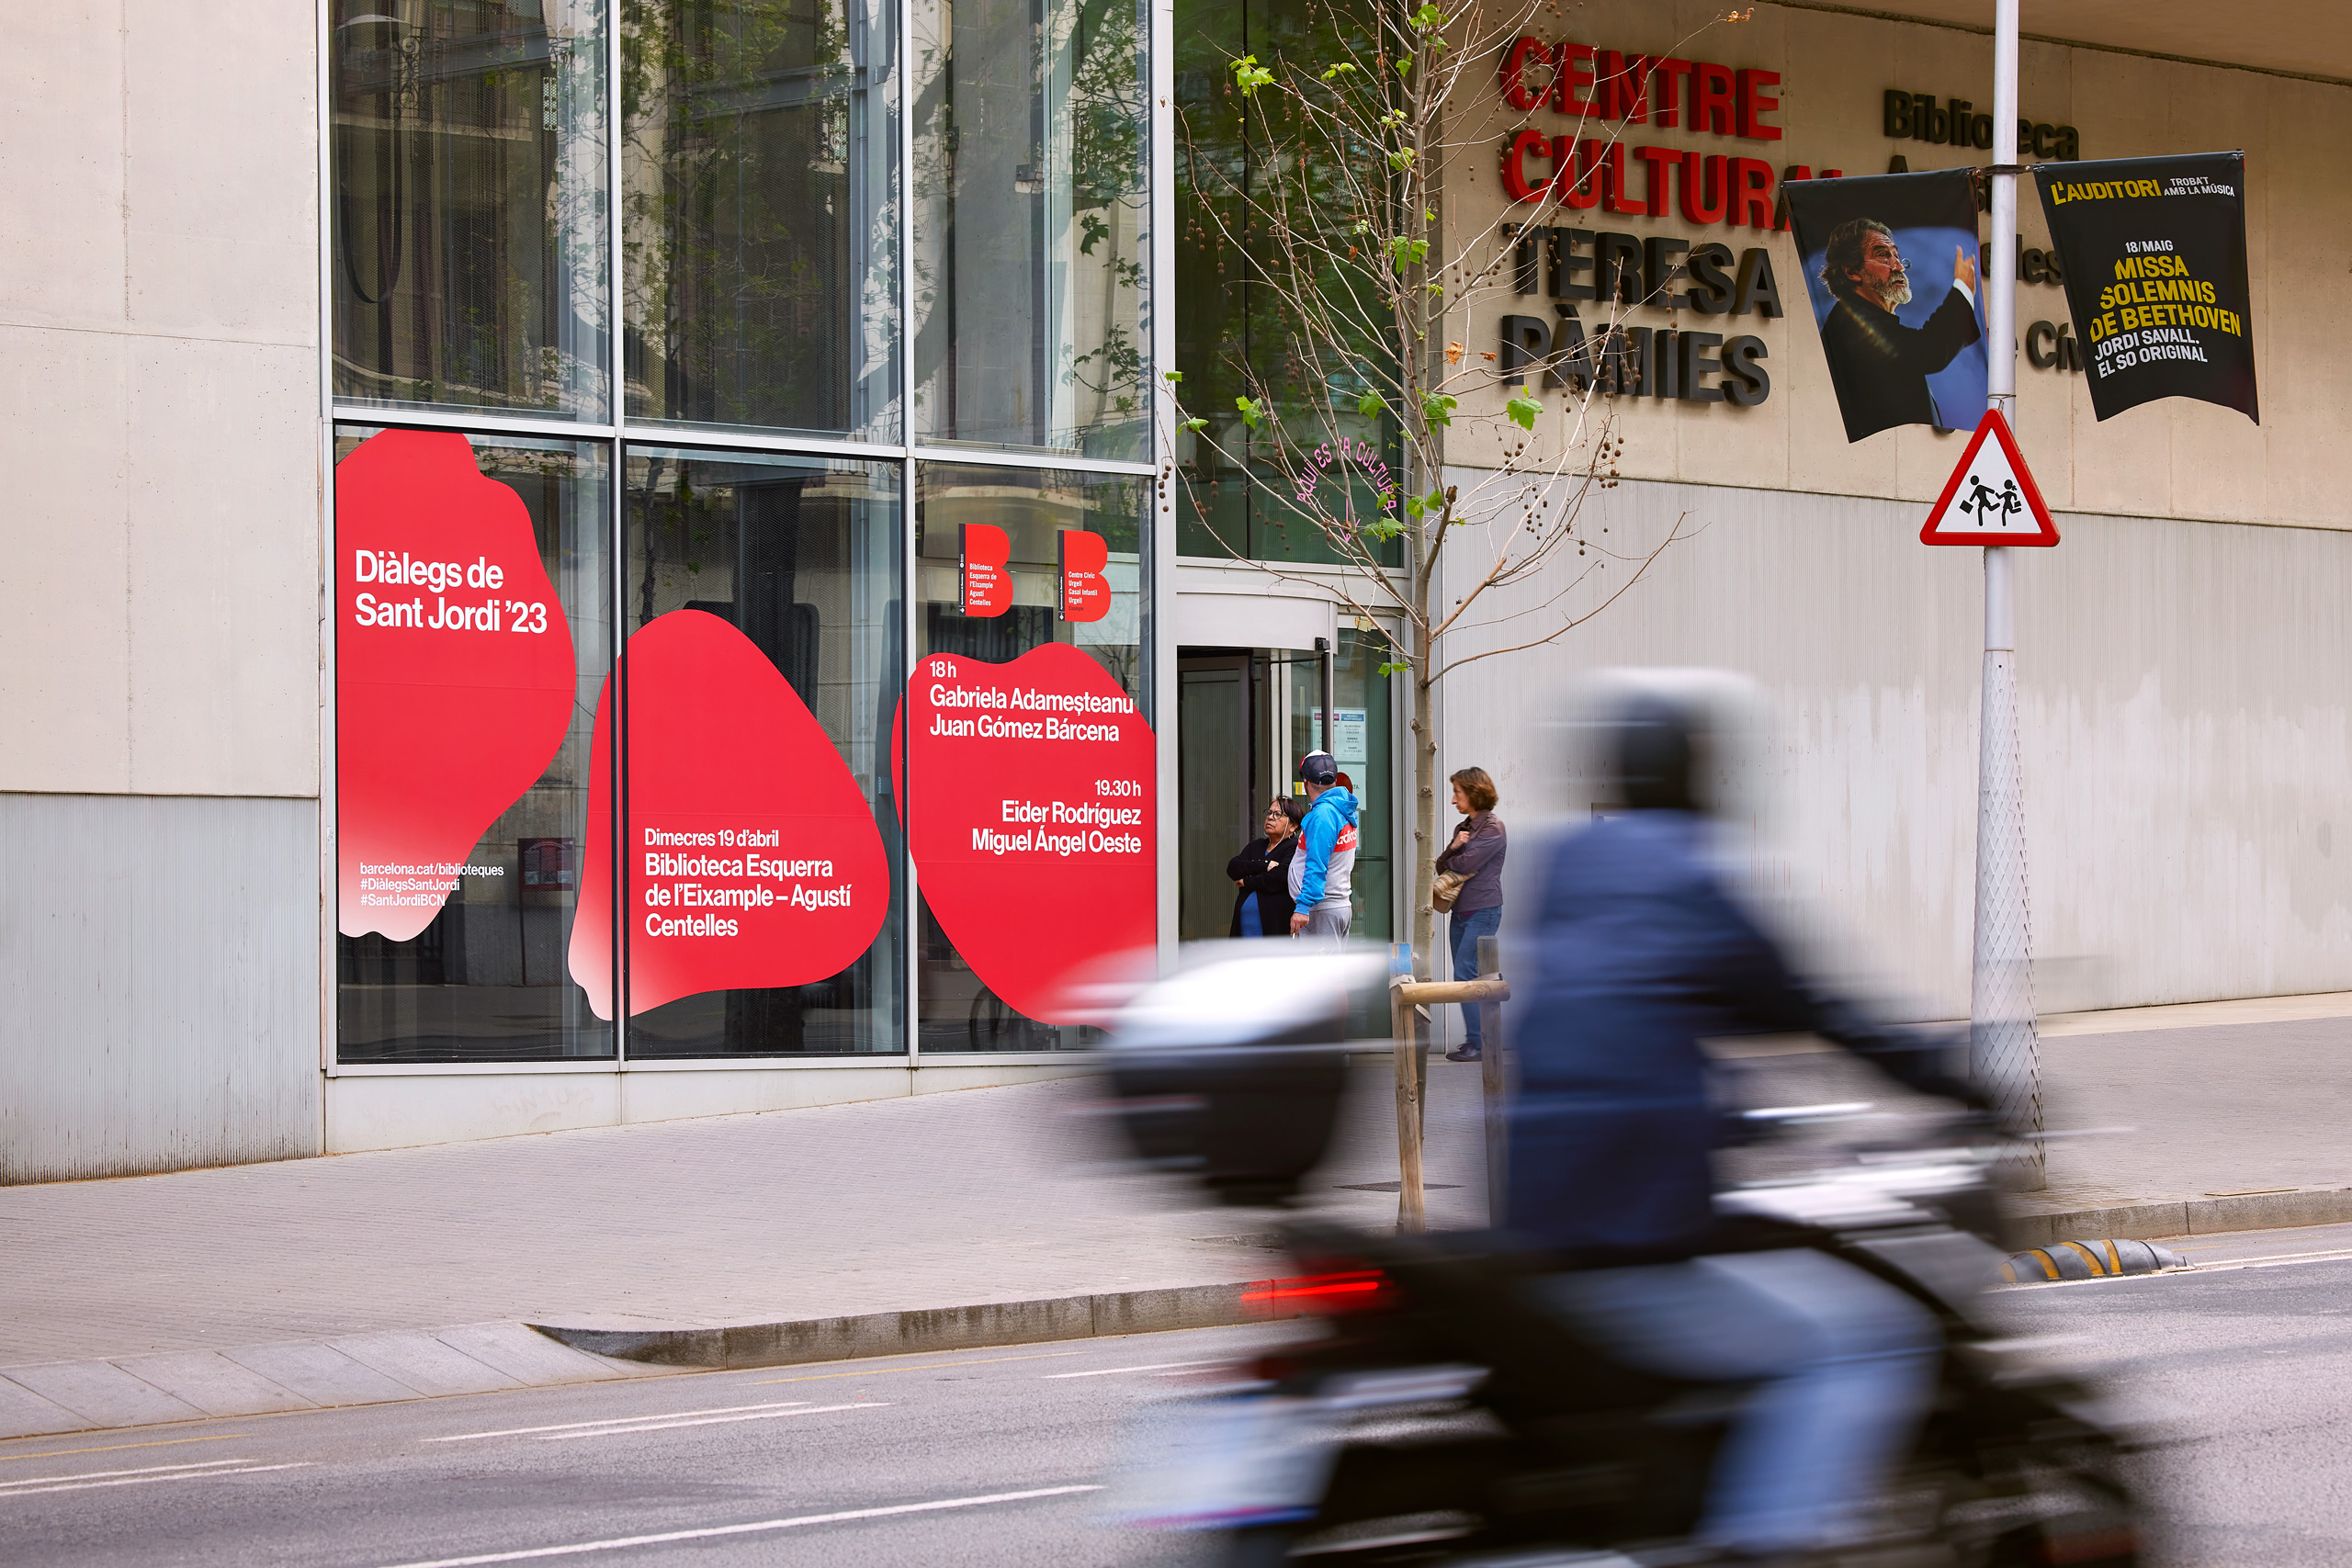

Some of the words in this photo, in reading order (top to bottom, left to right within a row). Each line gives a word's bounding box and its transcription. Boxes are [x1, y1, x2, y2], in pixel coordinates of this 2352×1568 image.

[1500, 36, 1782, 141] CENTRE
[1884, 89, 2079, 161] Biblioeca
[1502, 129, 1843, 233] CULTUR
[2051, 179, 2163, 206] L'AUDITORI
[2164, 186, 2186, 197] AMB
[2188, 186, 2201, 196] LA
[2201, 183, 2235, 197] MÚSICA
[2125, 240, 2174, 254] 18/MAIG
[1502, 223, 1783, 319] TERESA
[2114, 255, 2189, 280] MISSA
[2099, 279, 2216, 310] SOLEMNIS
[2089, 311, 2119, 344] DE
[2120, 304, 2242, 338] BEETHOVEN
[1502, 303, 1770, 407] PÀMIES
[2094, 332, 2140, 361] JORDI
[2141, 328, 2199, 345] SAVALL.
[2098, 360, 2116, 379] EL
[2115, 352, 2137, 370] SO
[2139, 344, 2209, 363] ORIGINAL
[356, 549, 463, 593] Diàlegs
[467, 557, 504, 589] de
[969, 563, 993, 571] Biblioteca
[969, 572, 990, 581] Esquerra
[355, 592, 424, 628] Sant
[427, 597, 501, 632] Jordi
[505, 601, 548, 634] '23
[1069, 597, 1082, 605] Urgell
[930, 661, 944, 678] 18
[947, 662, 956, 678] h
[930, 684, 1007, 709] Gabriela
[1011, 688, 1134, 716] Adameșteanu
[930, 714, 975, 737] Juan
[978, 715, 1043, 739] Gómez
[1046, 717, 1119, 742] Bárcena
[1094, 780, 1130, 796] 19.30
[1133, 781, 1141, 797] h
[1002, 800, 1049, 823] Eider
[1052, 801, 1141, 829] Rodríguez
[645, 828, 716, 847] Dimecres
[718, 829, 734, 846] 19
[737, 829, 779, 847] d'abril
[972, 829, 1032, 855] Miguel
[1035, 825, 1086, 857] Ángel
[1089, 832, 1141, 853] Oeste
[360, 863, 503, 878] barcelona.cat/biblioteques
[646, 853, 742, 876] Biblioteca
[747, 854, 833, 881] Esquerra
[360, 878, 460, 893] #DiàlegsSantJordi
[645, 884, 671, 907] de
[674, 884, 774, 911] l'Eixample
[791, 884, 852, 911] Agustí
[360, 894, 446, 907] #SantJordiBCN
[646, 913, 739, 937] Centelles
